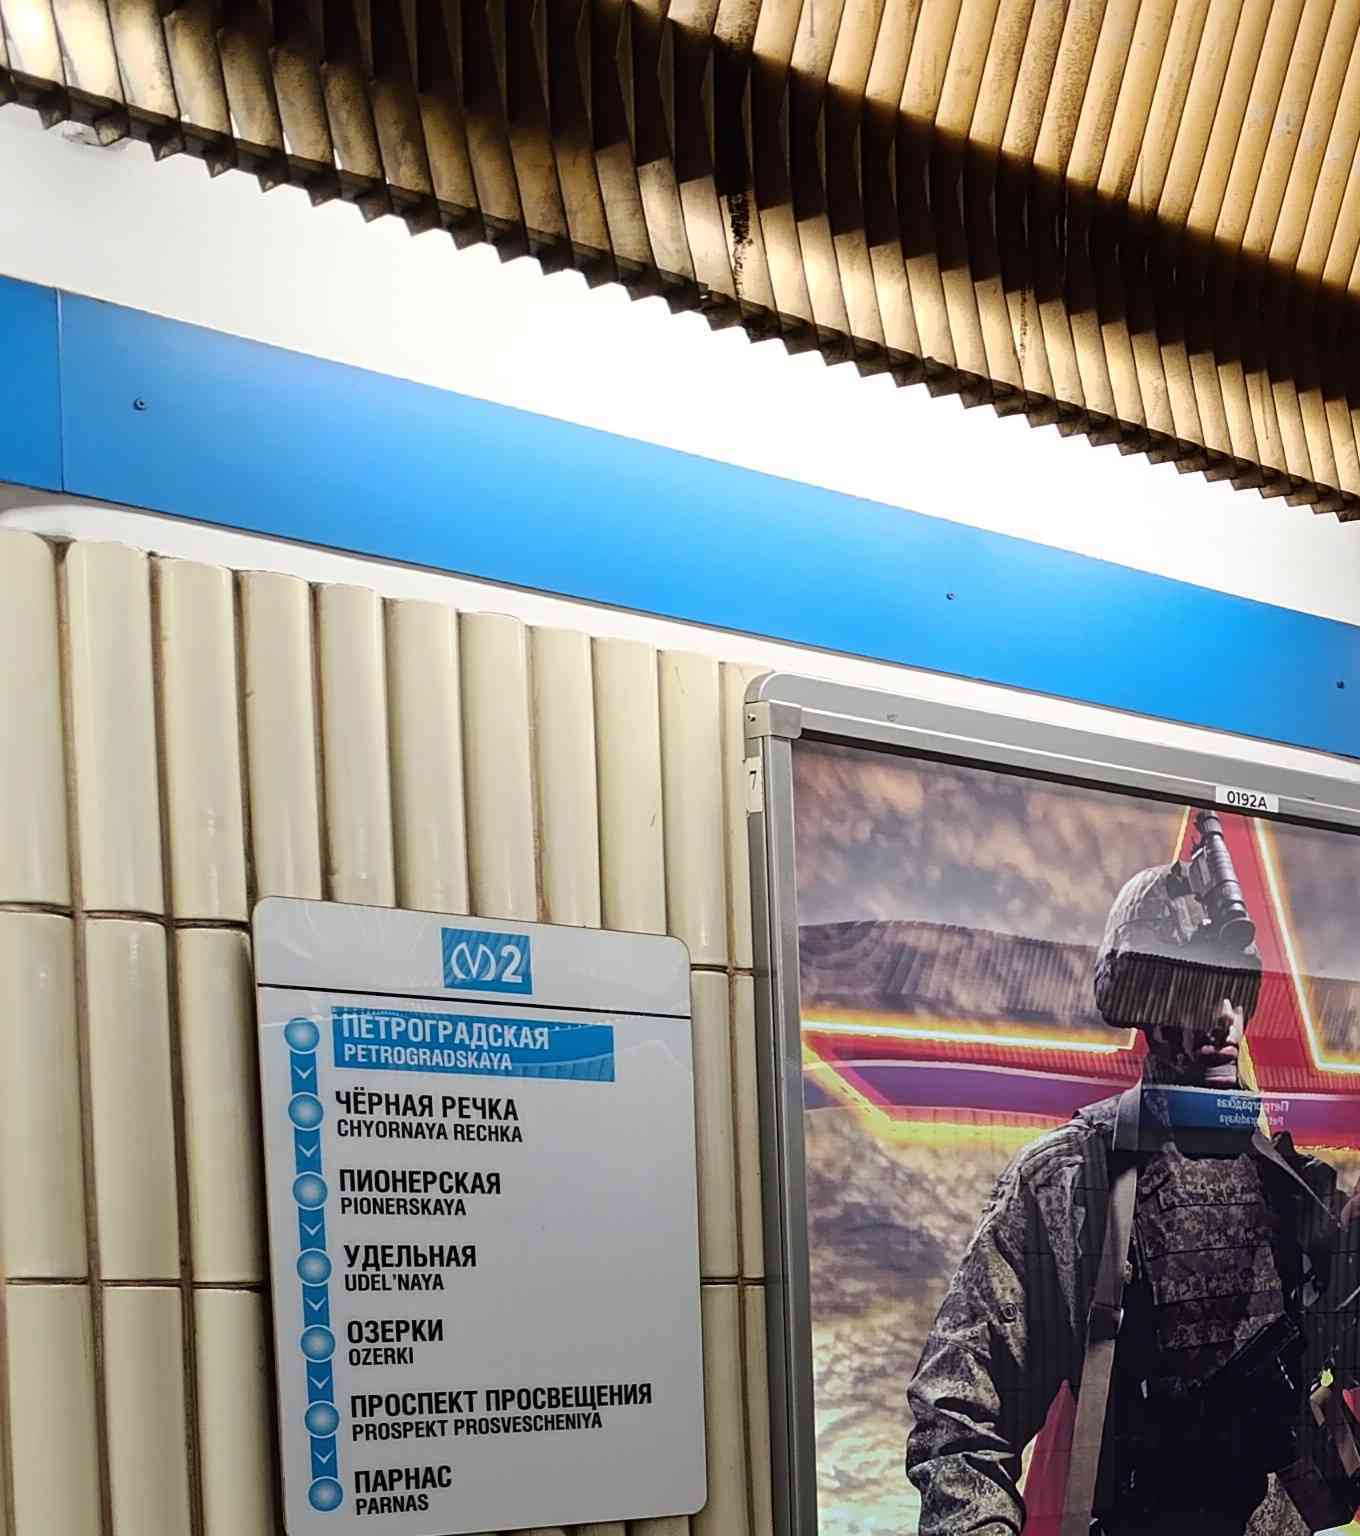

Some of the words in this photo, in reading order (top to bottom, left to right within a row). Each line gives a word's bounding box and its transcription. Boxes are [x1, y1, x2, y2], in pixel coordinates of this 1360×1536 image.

[1226, 790, 1268, 809] 0192A
[342, 1012, 550, 1050] ПЕТРОГРАДСКАЯ
[344, 1045, 513, 1071] PETROGRADSKAYA
[335, 1086, 434, 1119] ЧЁРНАЯ
[442, 1097, 519, 1121] РЕЧКА
[336, 1119, 448, 1141] CHYORNAYA
[454, 1123, 523, 1143] RECHKA
[339, 1168, 501, 1195] ПИОНЕРСКАЯ
[341, 1197, 467, 1216] PIONERSKAYA
[344, 1244, 477, 1271] УДЕЛЬНАЯ
[344, 1273, 444, 1292] UDEL'NAYA
[347, 1319, 444, 1344] ОЗЕРКИ
[348, 1347, 414, 1366] OZERKI
[350, 1390, 479, 1418] ПРОСПЕКТ
[485, 1383, 653, 1413] ПРОСВЕЩЕНИЯ
[352, 1419, 448, 1441] PROSPEKT
[454, 1412, 603, 1436] PROSVESCHENIYA
[354, 1465, 452, 1494] ПАРНАС
[355, 1495, 429, 1516] PARNAS
